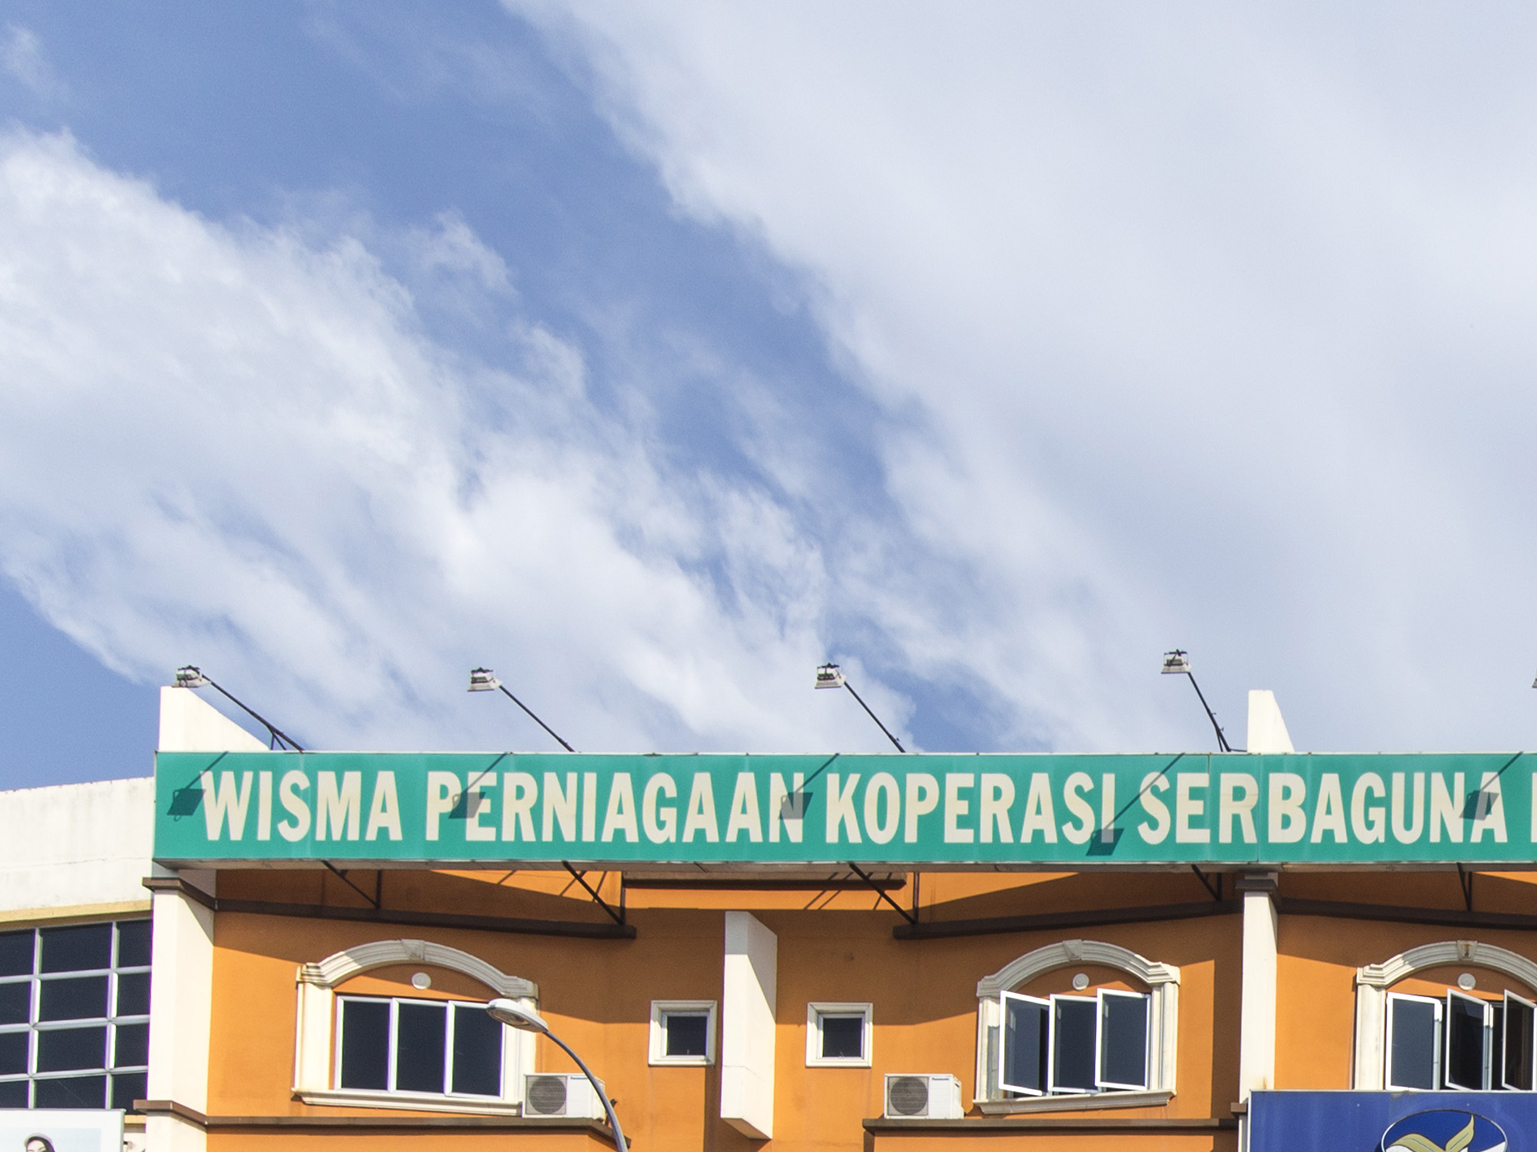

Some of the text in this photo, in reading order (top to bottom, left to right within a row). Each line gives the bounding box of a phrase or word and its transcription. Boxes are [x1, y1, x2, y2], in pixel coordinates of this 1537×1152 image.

[200, 769, 403, 842] WISMA
[425, 771, 805, 844] PERNIAGAAN
[825, 771, 1116, 844] KOPERASI
[1138, 771, 1509, 845] SERBAGUNA
